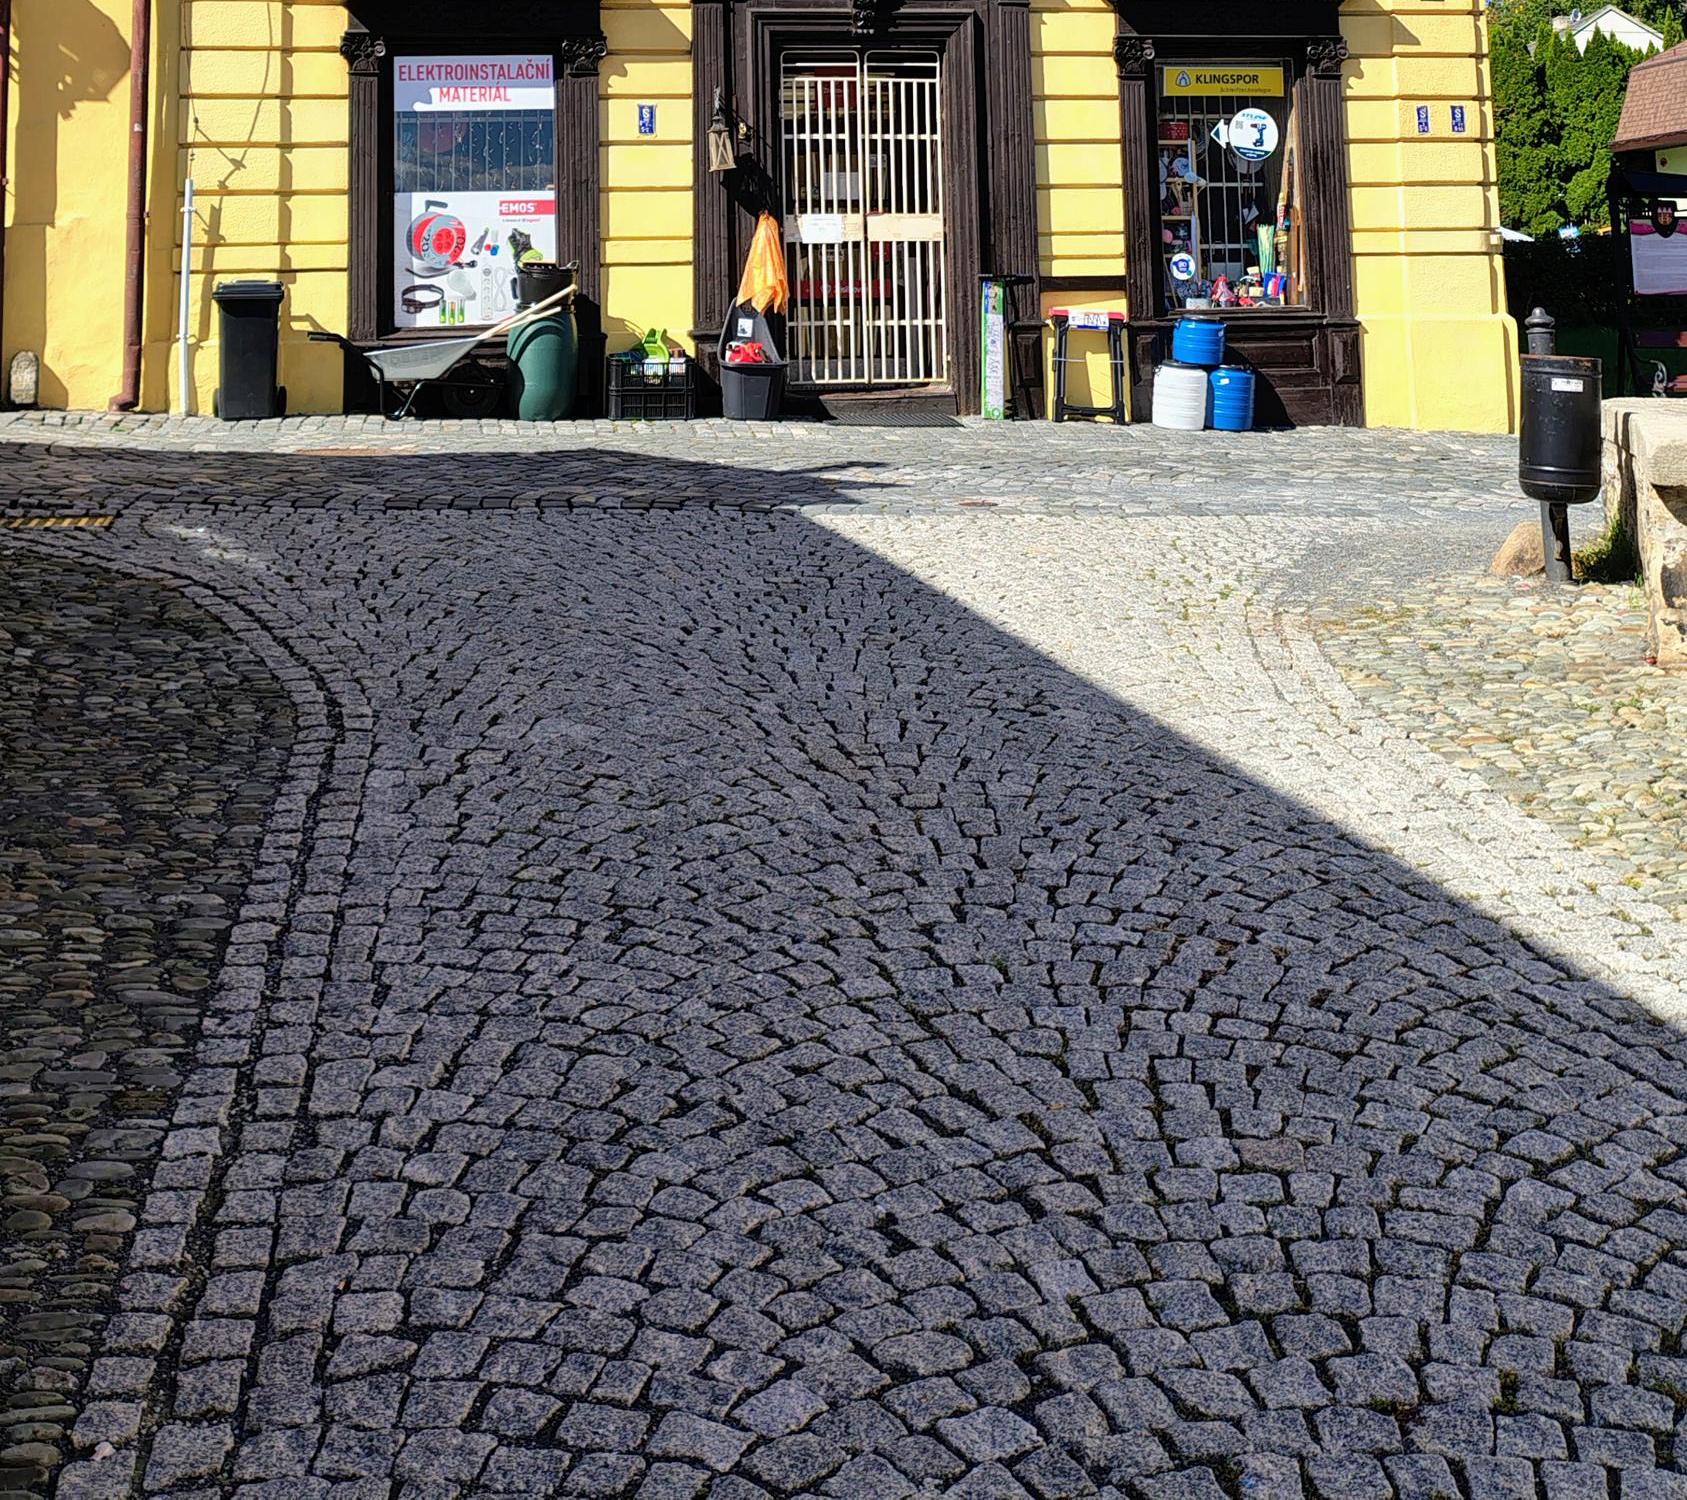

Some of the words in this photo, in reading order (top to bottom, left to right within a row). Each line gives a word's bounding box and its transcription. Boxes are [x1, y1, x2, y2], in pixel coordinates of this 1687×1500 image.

[398, 58, 550, 81] ELEKTROINSTALAČNÍ
[1195, 73, 1259, 84] KLINGSPOR
[439, 81, 511, 102] MATERIÁL
[501, 202, 535, 213] EMOS
